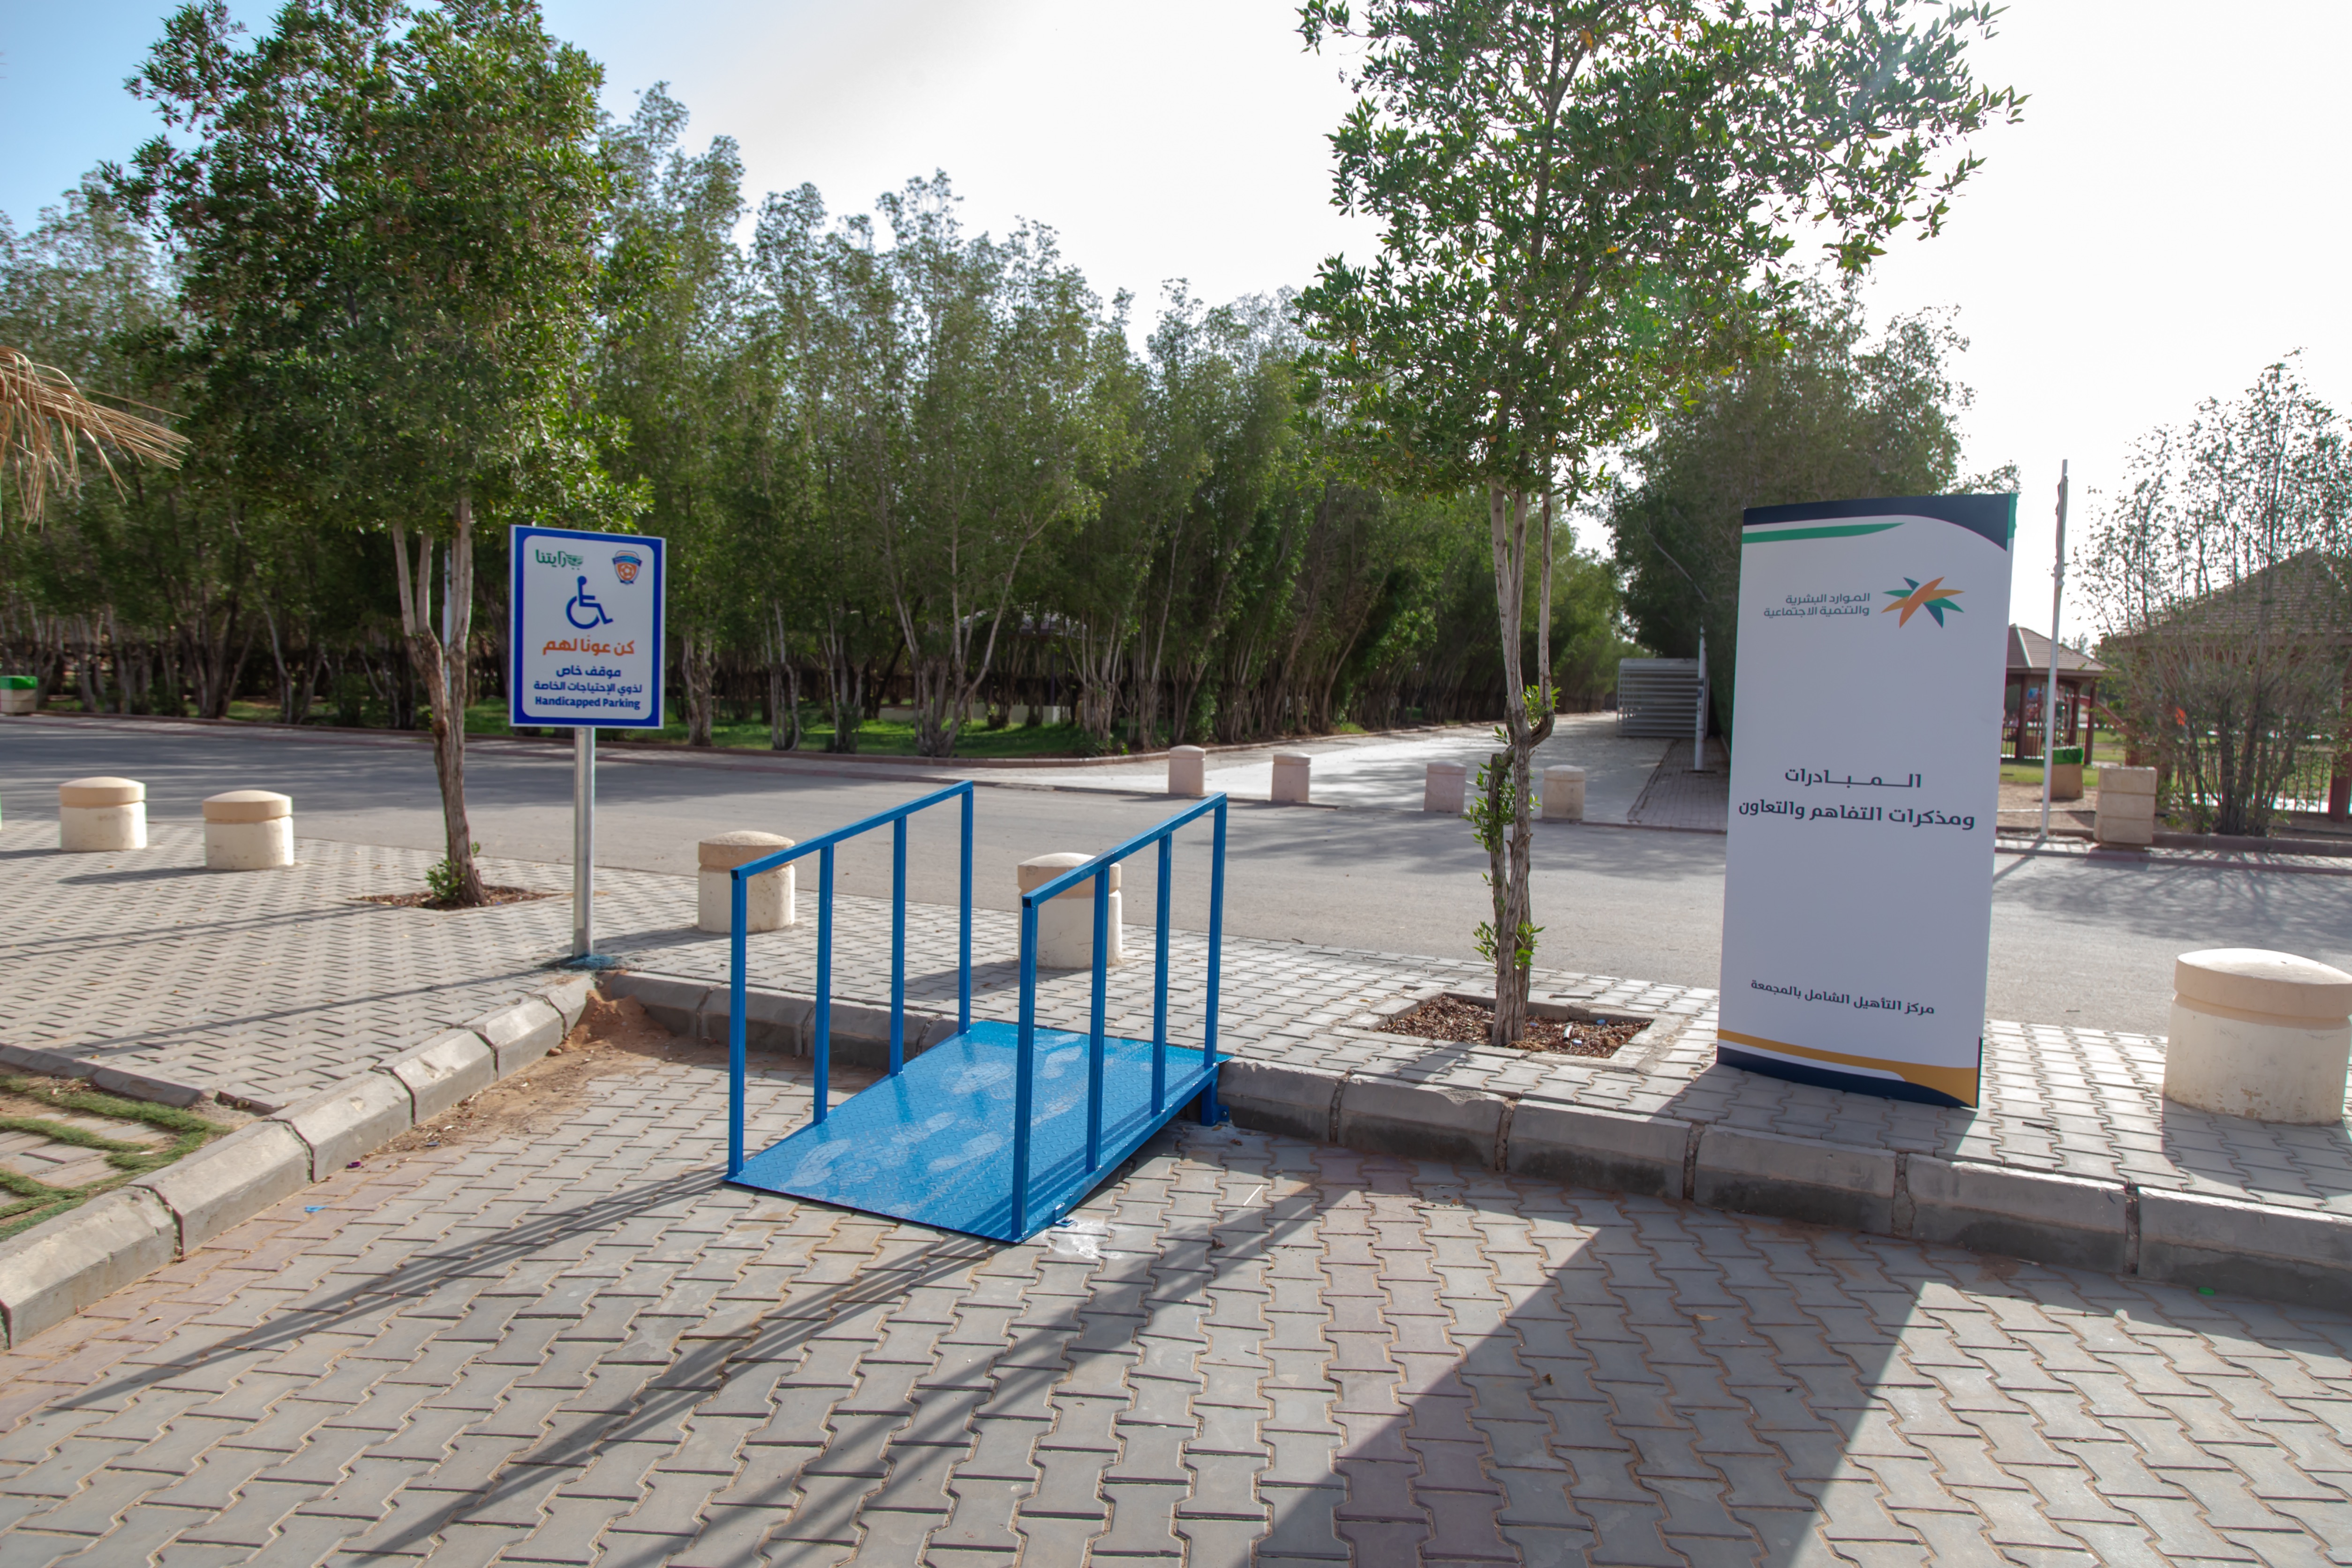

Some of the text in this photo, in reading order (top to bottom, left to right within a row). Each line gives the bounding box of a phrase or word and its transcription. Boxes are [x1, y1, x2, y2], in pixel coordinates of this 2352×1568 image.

[1786, 593, 1870, 605] الموارد البشرية
[1764, 606, 1870, 618] والتنمية الاجتماعية
[543, 638, 577, 655] لهم
[614, 640, 634, 656] كن
[556, 665, 621, 679] موقف خاص
[534, 681, 565, 690] الخاصة
[617, 684, 642, 696] لذوي
[535, 696, 641, 710] Handicapped Parking
[1785, 769, 1921, 788] المبادرات
[1739, 799, 1975, 830] ومذكرات التفاهم والتعاون
[1751, 980, 1935, 1015] مركز التأهيل الشامل بالمجمعة
